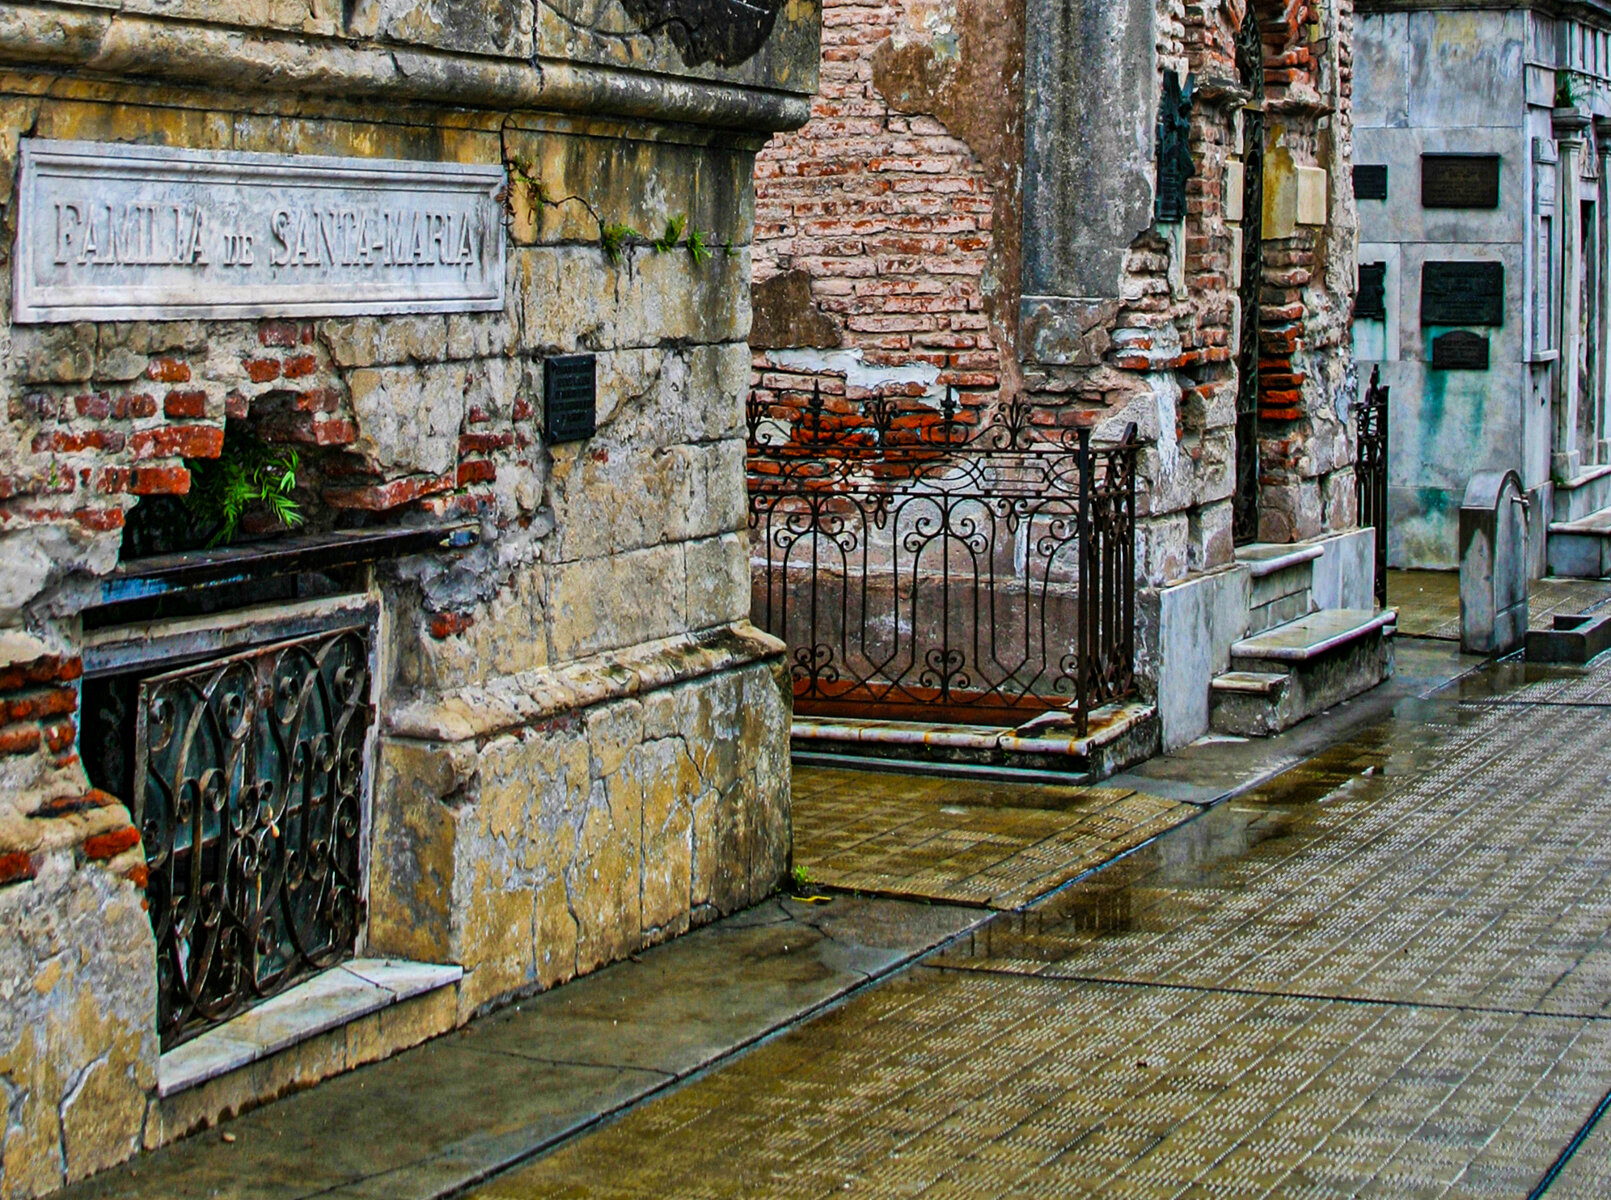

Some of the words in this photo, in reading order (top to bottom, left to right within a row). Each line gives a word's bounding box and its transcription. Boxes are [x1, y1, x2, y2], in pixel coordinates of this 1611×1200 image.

[53, 202, 210, 267] FAMILIA
[223, 233, 255, 267] DE
[268, 207, 474, 267] SANTA-MARIA
